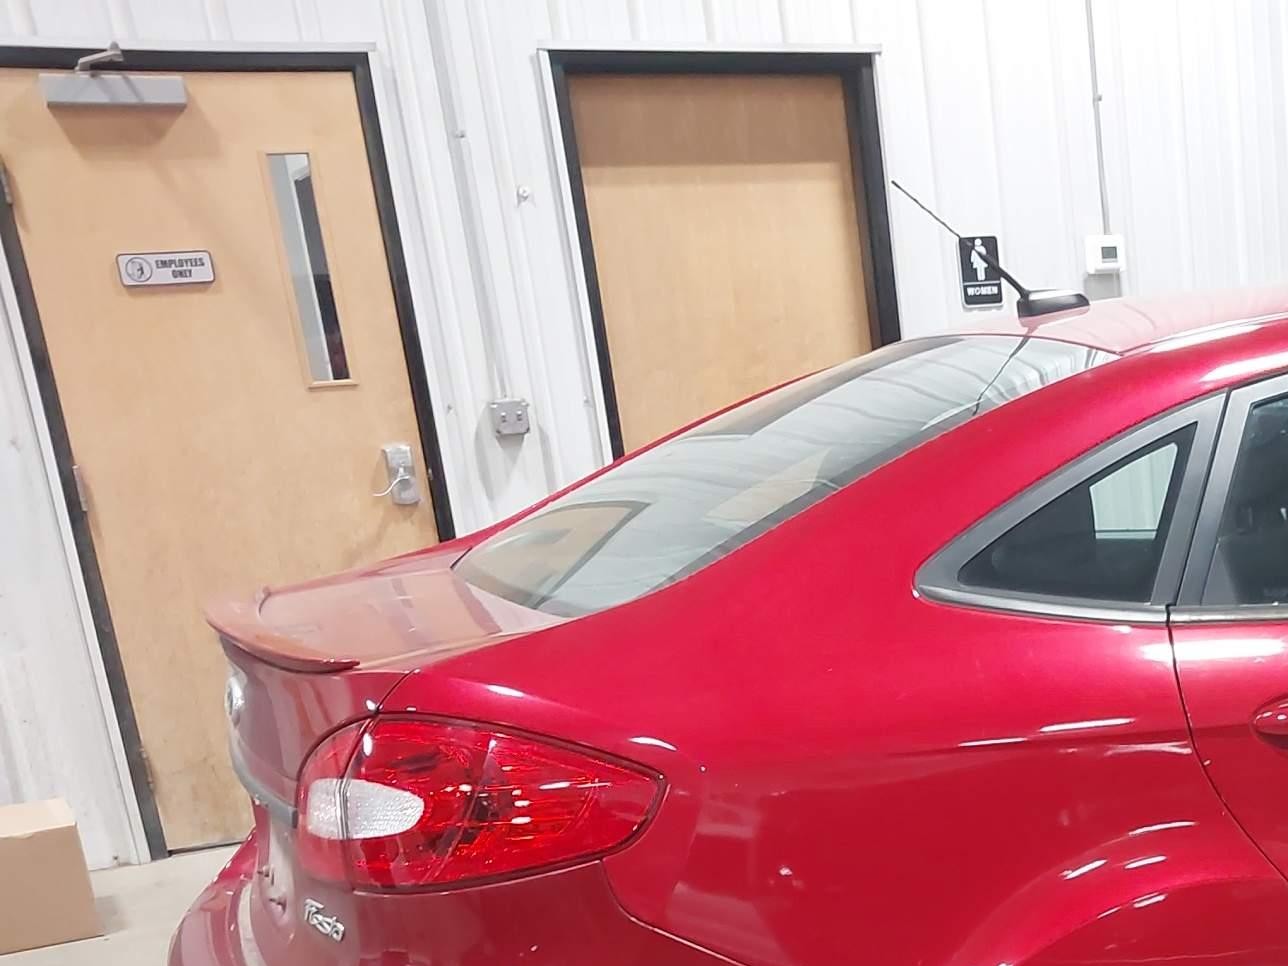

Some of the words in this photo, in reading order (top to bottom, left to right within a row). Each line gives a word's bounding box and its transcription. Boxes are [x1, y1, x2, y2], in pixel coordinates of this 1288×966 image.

[155, 258, 205, 269] EMPLOYEES
[171, 269, 192, 279] ONLY
[966, 286, 998, 296] WOMEN
